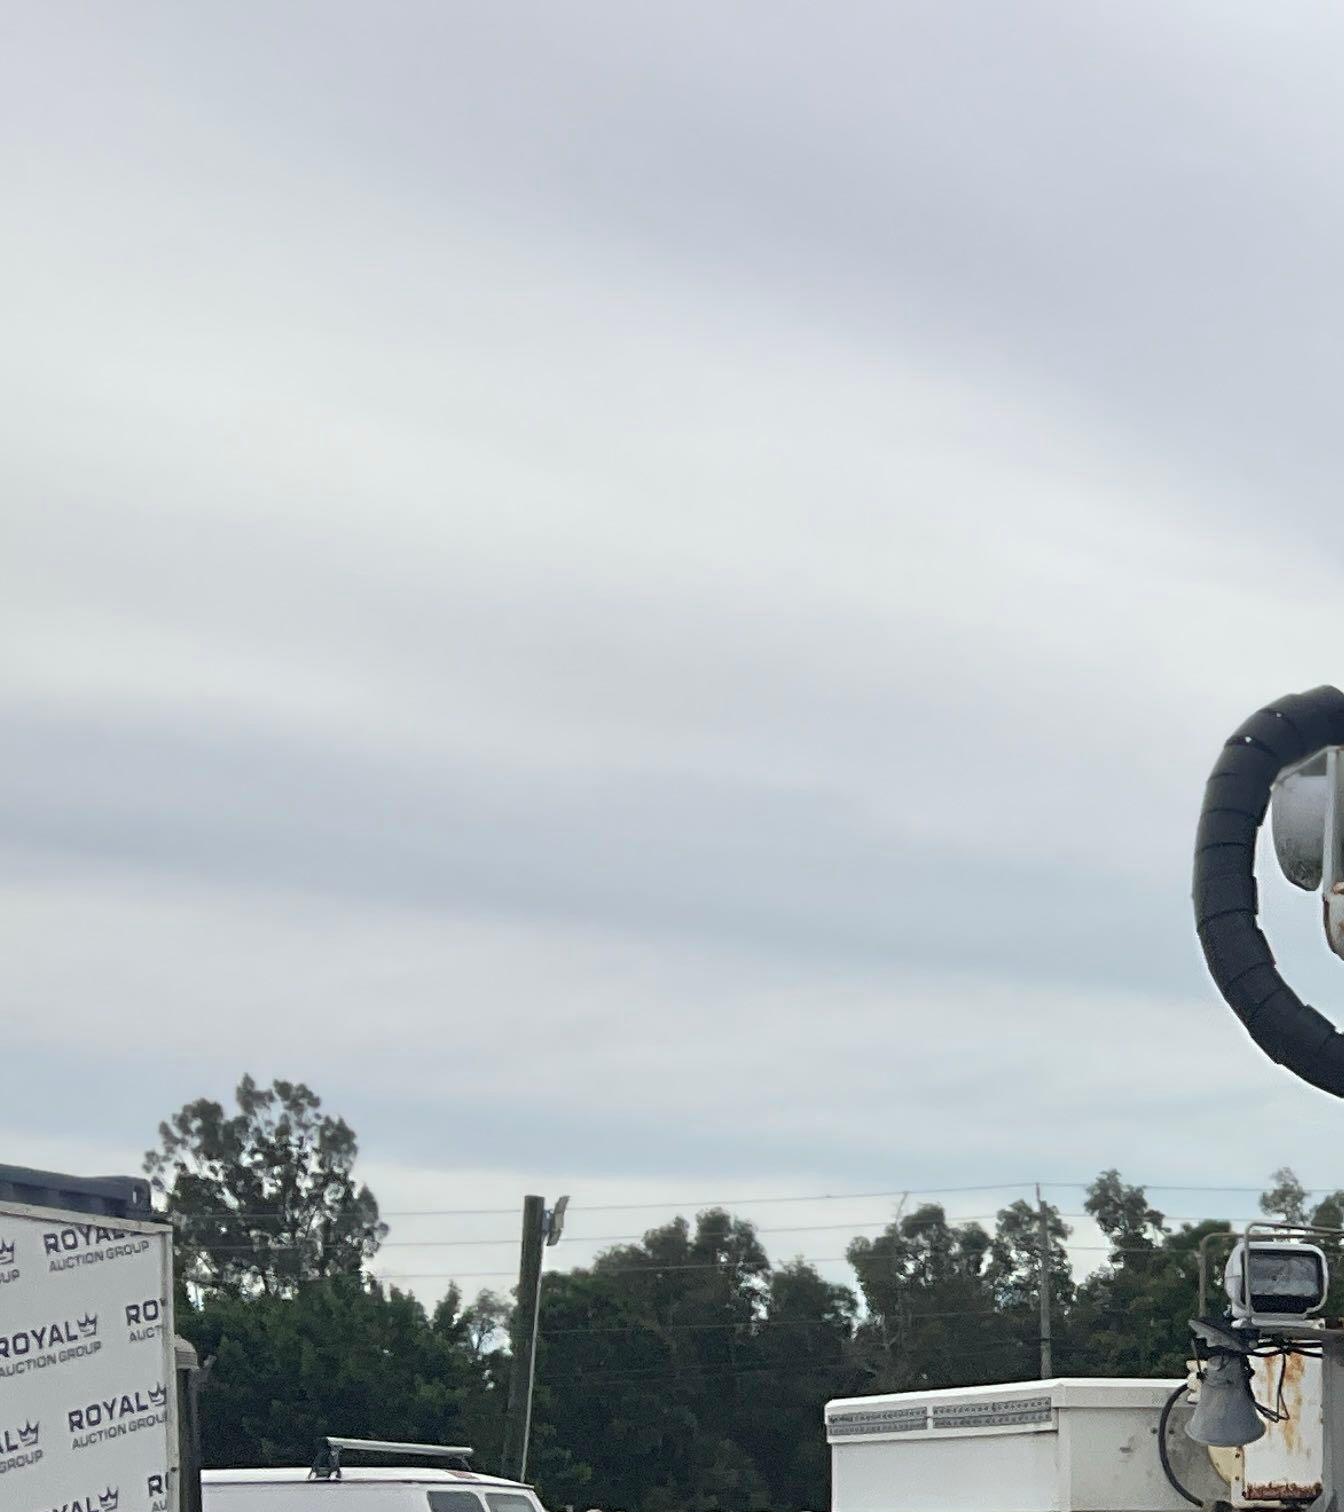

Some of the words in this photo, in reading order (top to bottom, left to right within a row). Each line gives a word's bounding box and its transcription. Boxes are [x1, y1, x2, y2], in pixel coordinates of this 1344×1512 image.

[49, 1252, 104, 1272] AUCTION
[105, 1240, 149, 1259] GROUP
[0, 1321, 78, 1358] ROYAL
[58, 1340, 102, 1363] GROUP
[69, 1392, 148, 1432] ROYAL
[72, 1424, 126, 1449] AUCTION
